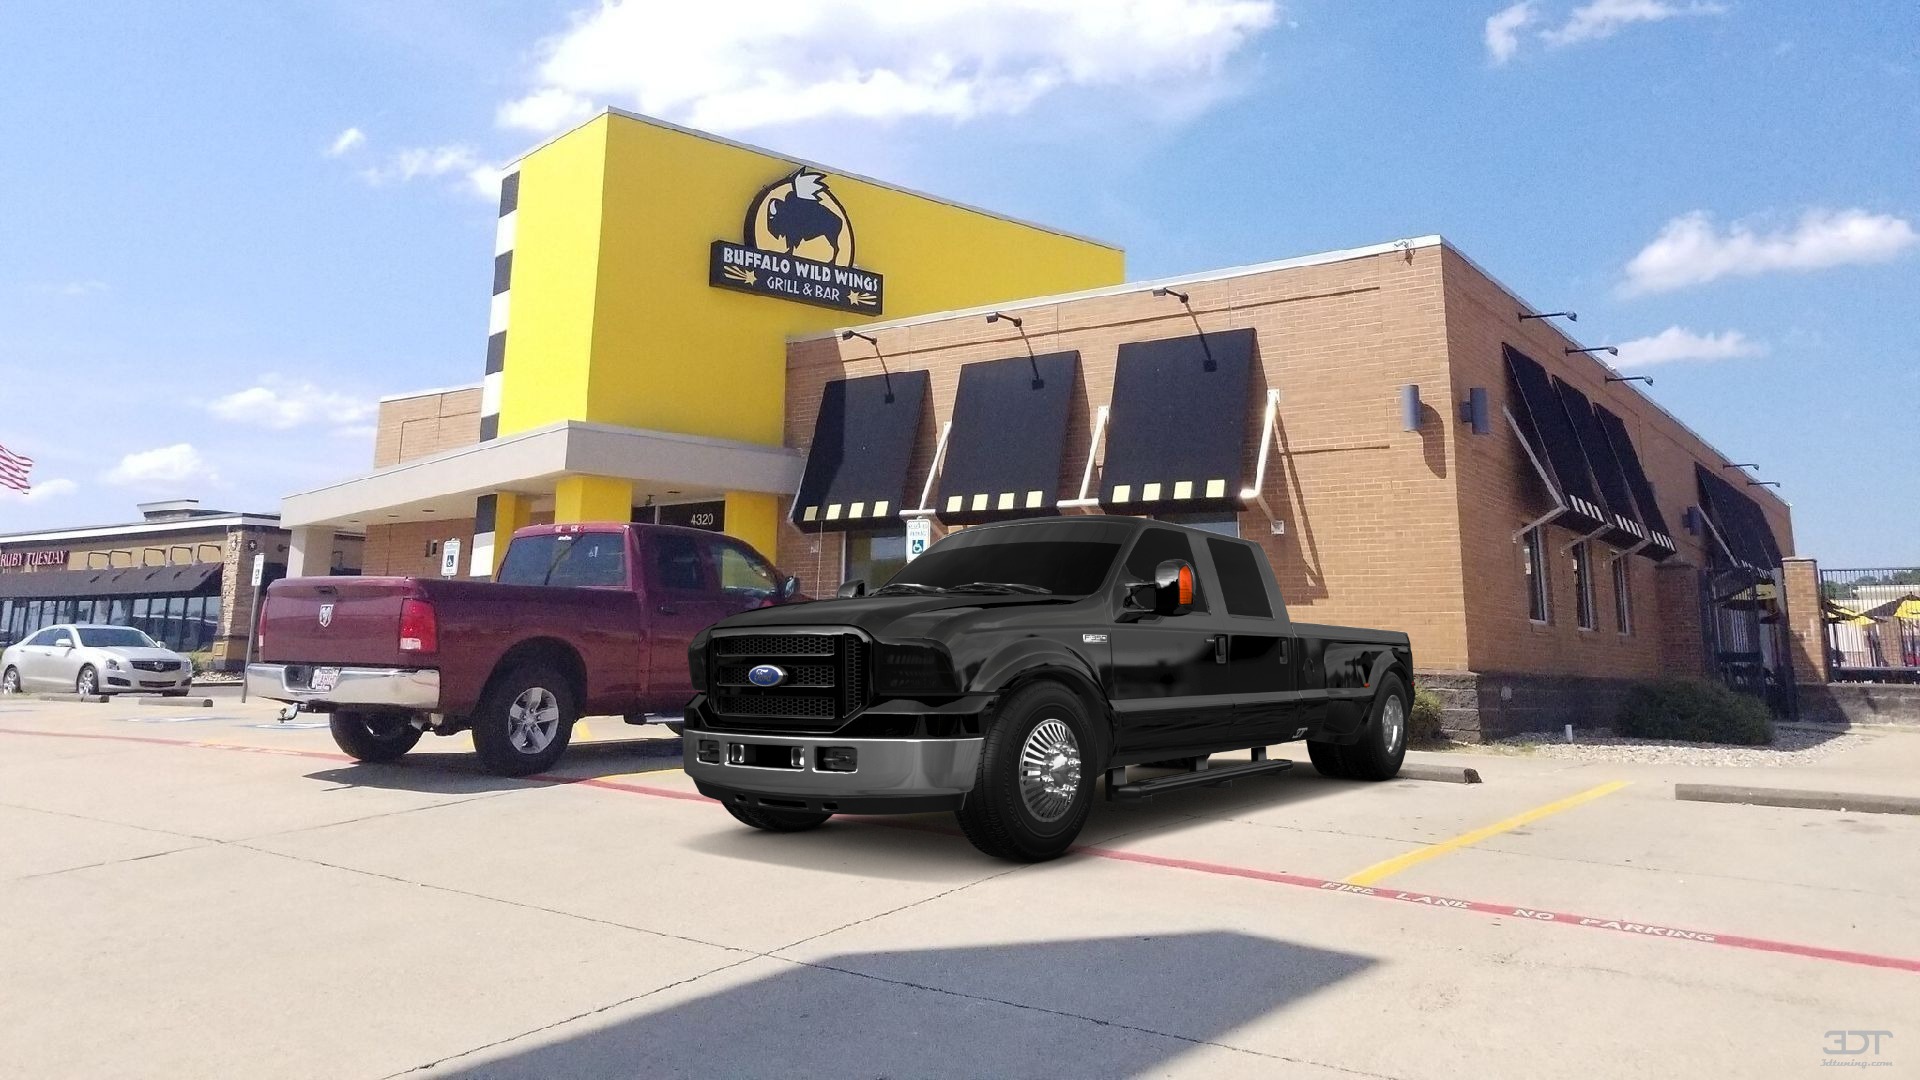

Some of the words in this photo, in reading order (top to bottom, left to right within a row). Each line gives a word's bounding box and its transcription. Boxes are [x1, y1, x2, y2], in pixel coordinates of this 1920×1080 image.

[723, 247, 790, 274] BUFFALO
[795, 261, 831, 282] WILD
[835, 269, 878, 292] WINGS
[767, 276, 799, 294] GRILL
[802, 283, 812, 296] &
[815, 286, 840, 301] BAR
[691, 513, 714, 526] 4320
[0, 552, 22, 567] RUBY
[26, 550, 65, 566] TUESDAY
[1320, 882, 1376, 895] FIRE
[1395, 892, 1472, 909] LANE
[1513, 908, 1556, 920] NO
[1579, 917, 1716, 943] PARKING
